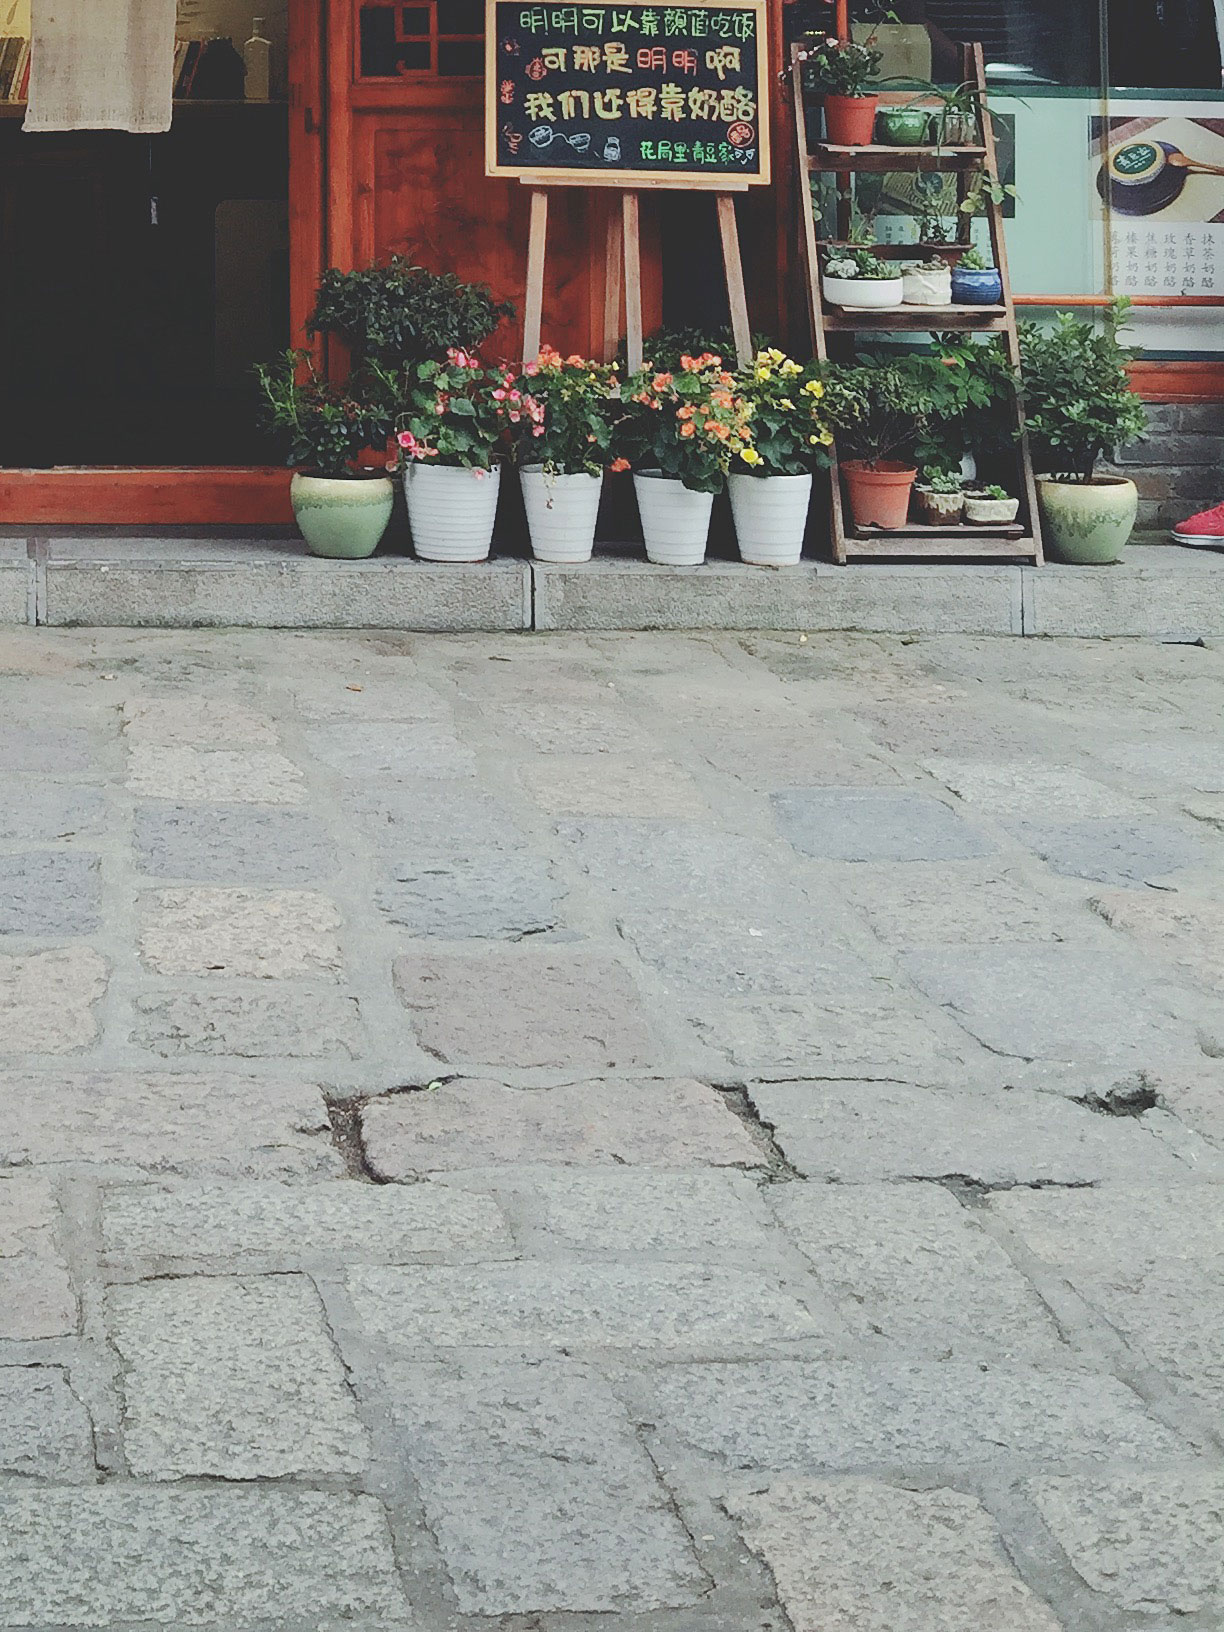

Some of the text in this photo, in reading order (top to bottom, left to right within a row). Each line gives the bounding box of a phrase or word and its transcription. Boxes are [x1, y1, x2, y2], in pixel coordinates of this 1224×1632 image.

[523, 82, 758, 122] 我们还得靠奶酪
[1163, 232, 1177, 288] 玫瑰奶酪
[1182, 232, 1196, 288] 香草奶酪
[1201, 233, 1216, 289] 抹茶奶酪
